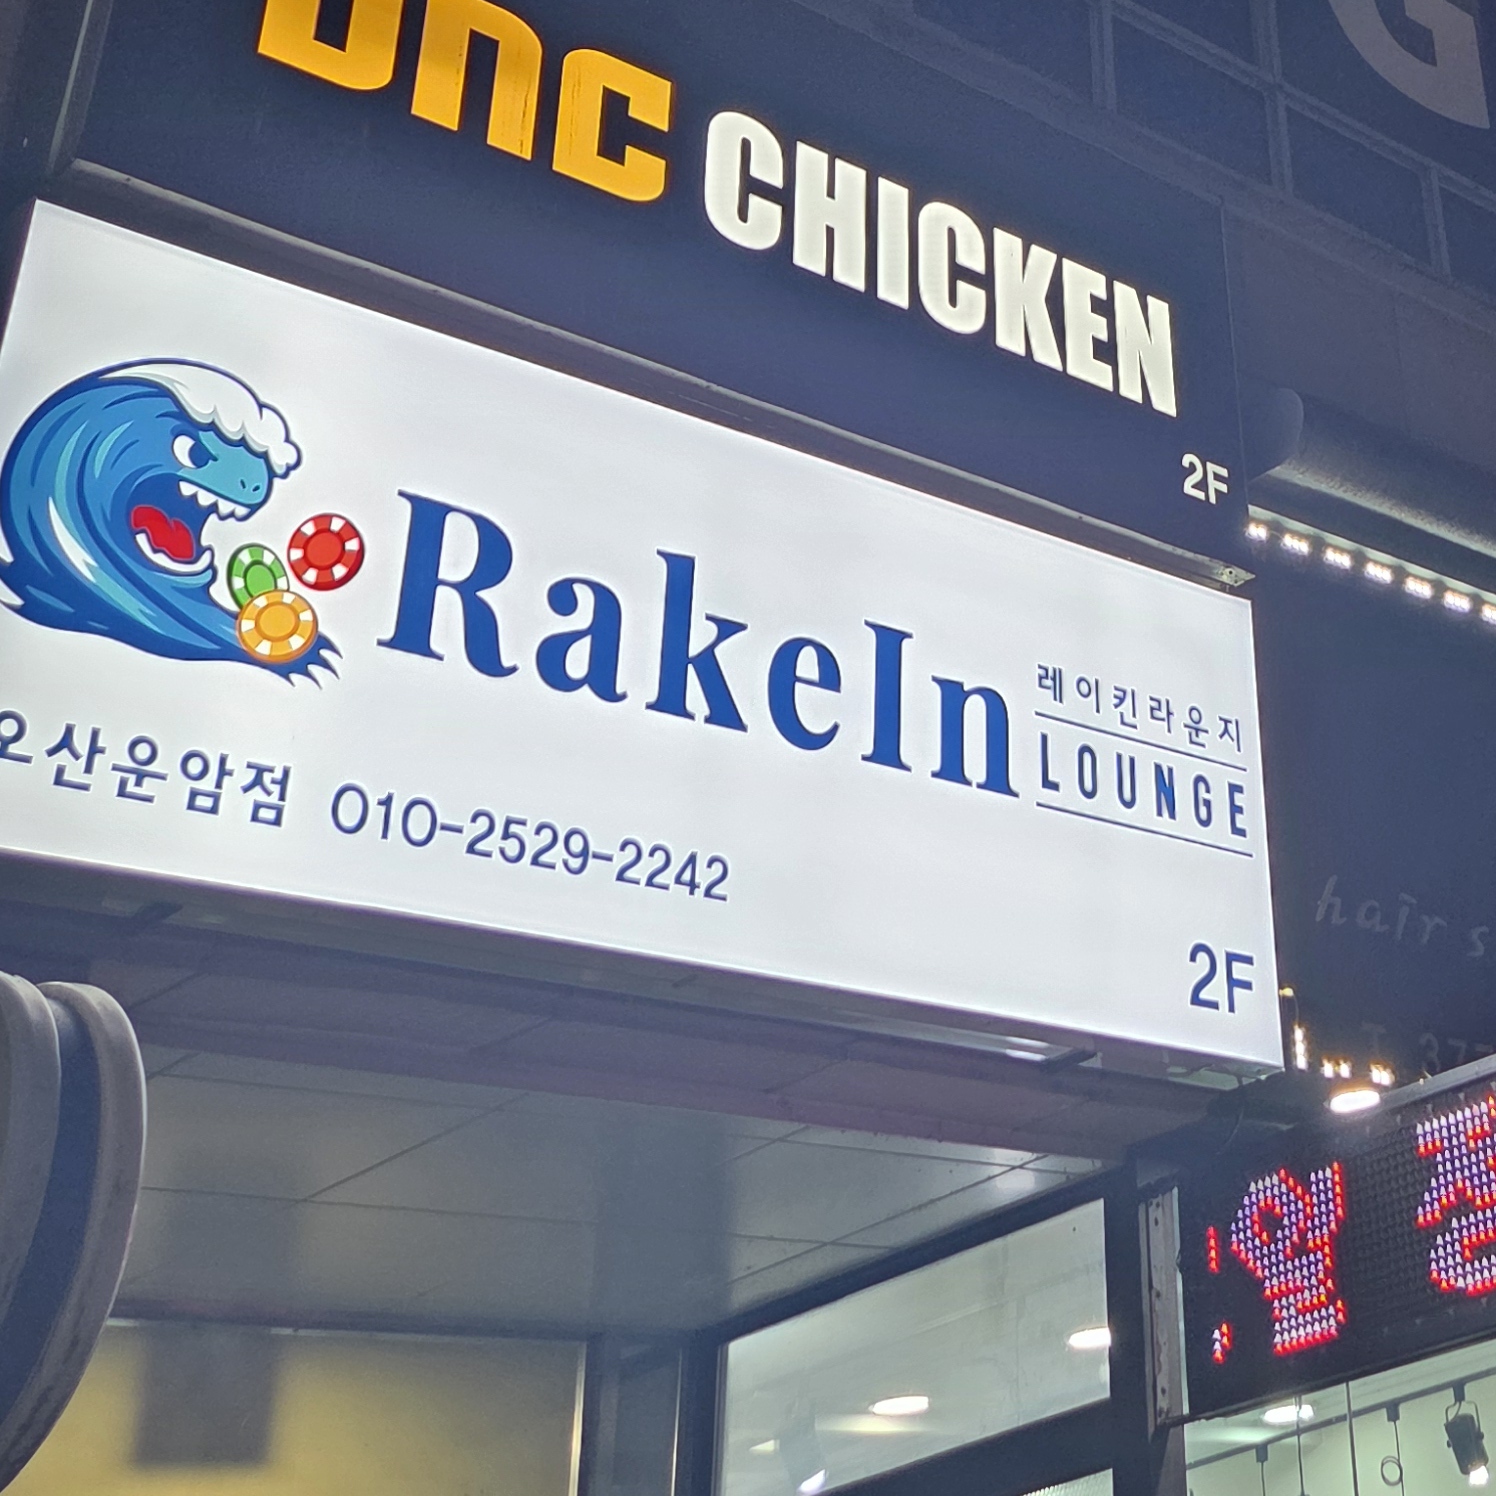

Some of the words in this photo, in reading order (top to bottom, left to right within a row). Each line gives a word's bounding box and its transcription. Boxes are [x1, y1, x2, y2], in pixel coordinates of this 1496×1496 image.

[703, 110, 1178, 418] CHICKEN
[1181, 452, 1229, 504] 2F
[376, 488, 1020, 798] RakeIn
[1036, 663, 1243, 754] 레이킨라운지
[0, 710, 294, 828] 오산운암점
[331, 781, 730, 902] 010-2529-2242
[1038, 732, 1248, 840] LOUNGE
[1314, 874, 1448, 947] hair
[1188, 942, 1255, 1014] 2F
